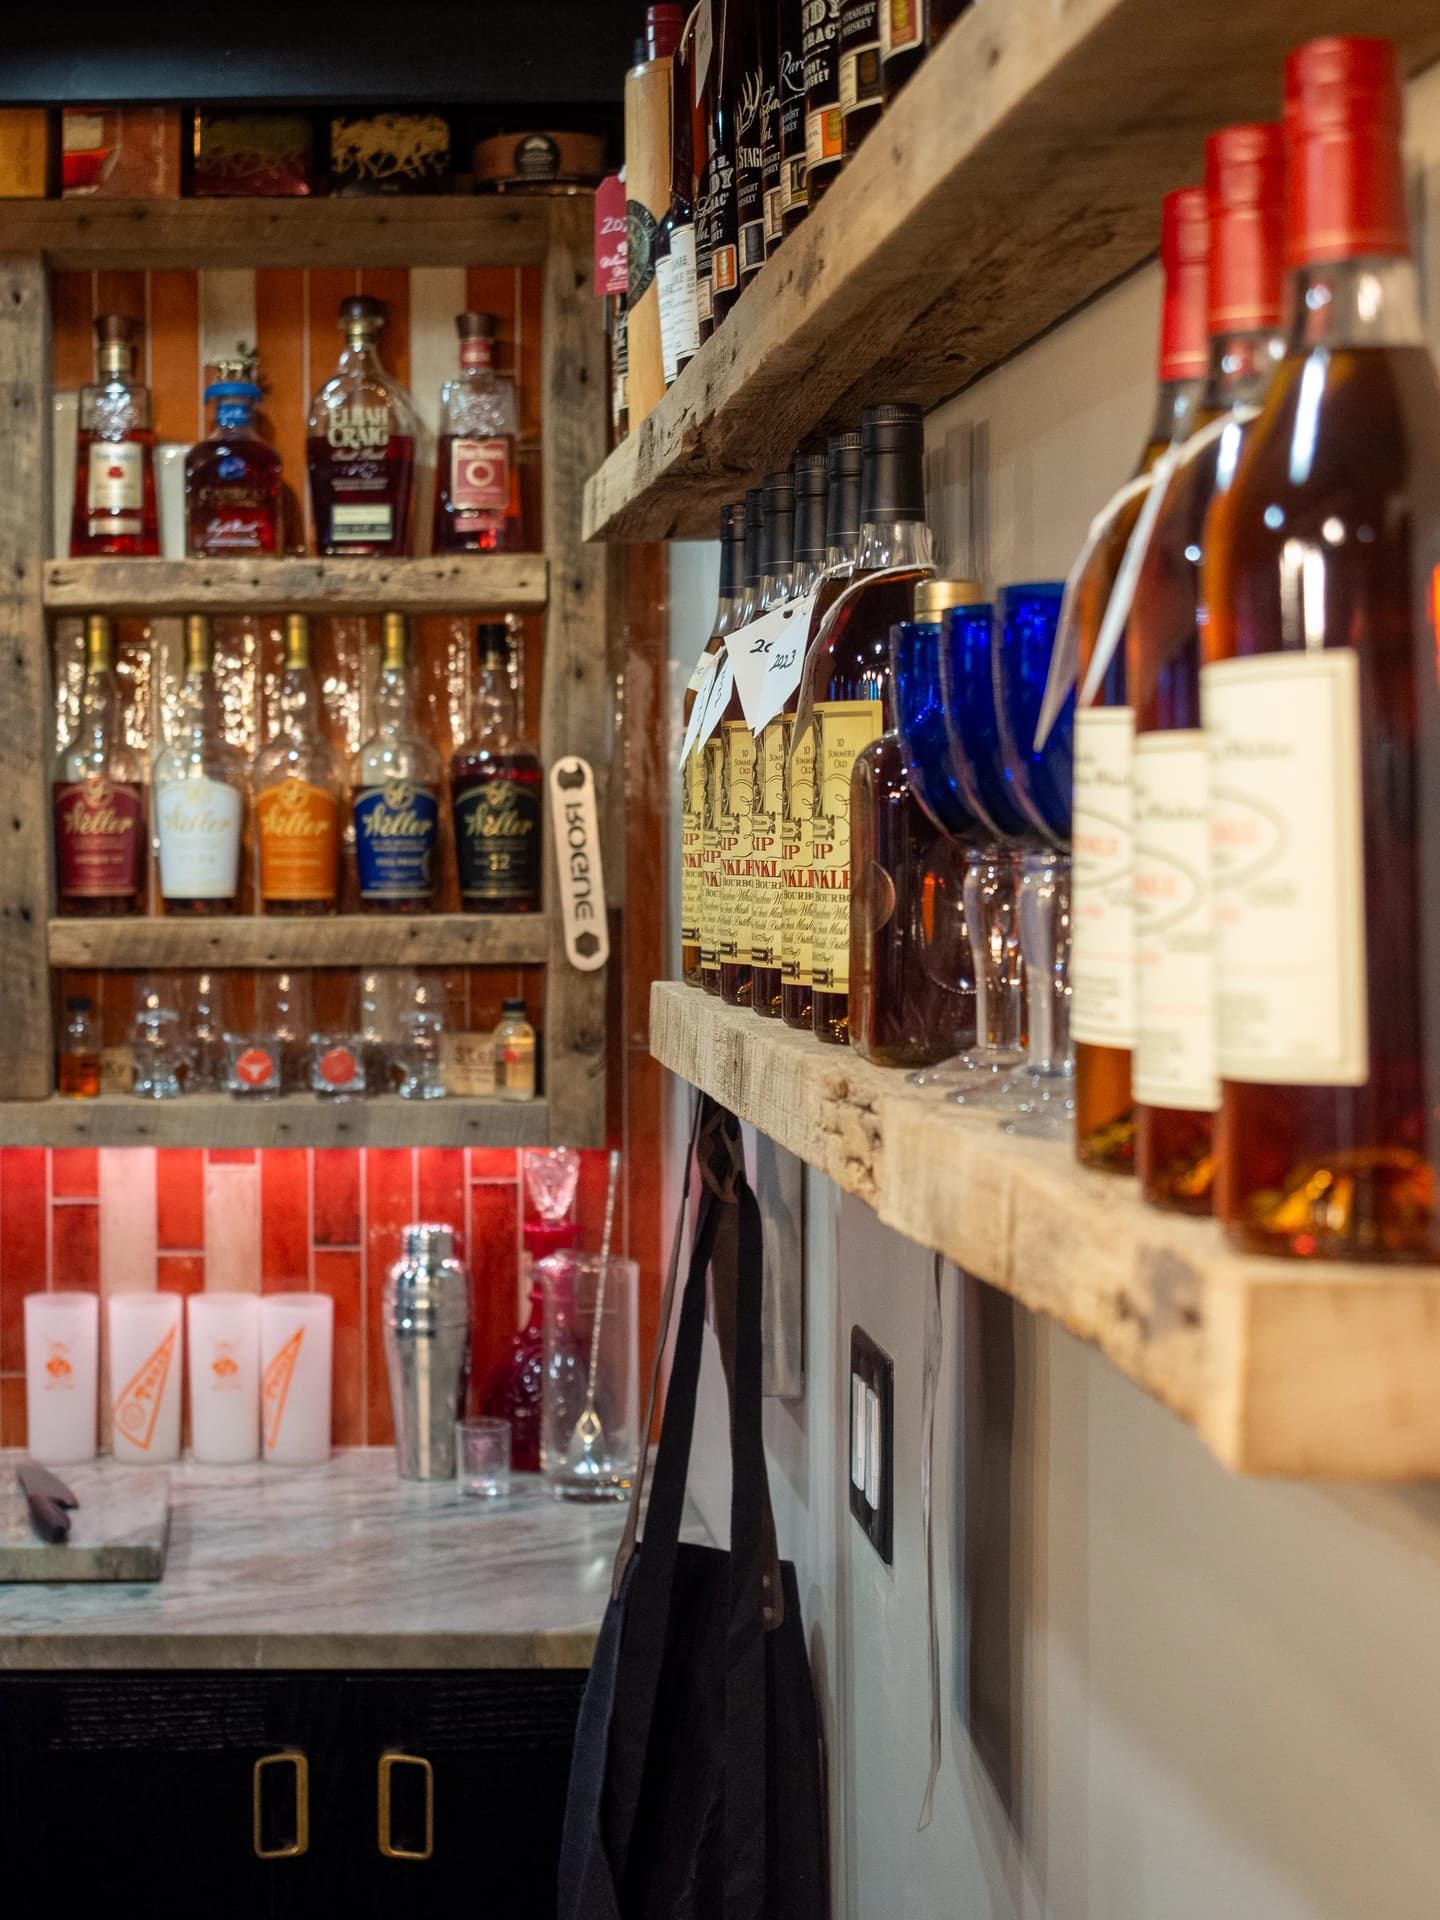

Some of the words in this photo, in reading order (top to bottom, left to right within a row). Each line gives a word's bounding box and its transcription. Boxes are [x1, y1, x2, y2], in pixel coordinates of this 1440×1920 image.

[329, 405, 389, 426] ELIJAH
[328, 426, 389, 448] CRAIG
[769, 649, 796, 672] 2023
[828, 750, 856, 759] SUMMERS
[833, 759, 848, 768] OLD
[62, 801, 134, 834] Weller
[261, 803, 330, 837] Weller
[361, 802, 433, 838] Weller
[463, 802, 534, 837] Weller
[489, 853, 511, 871] 12
